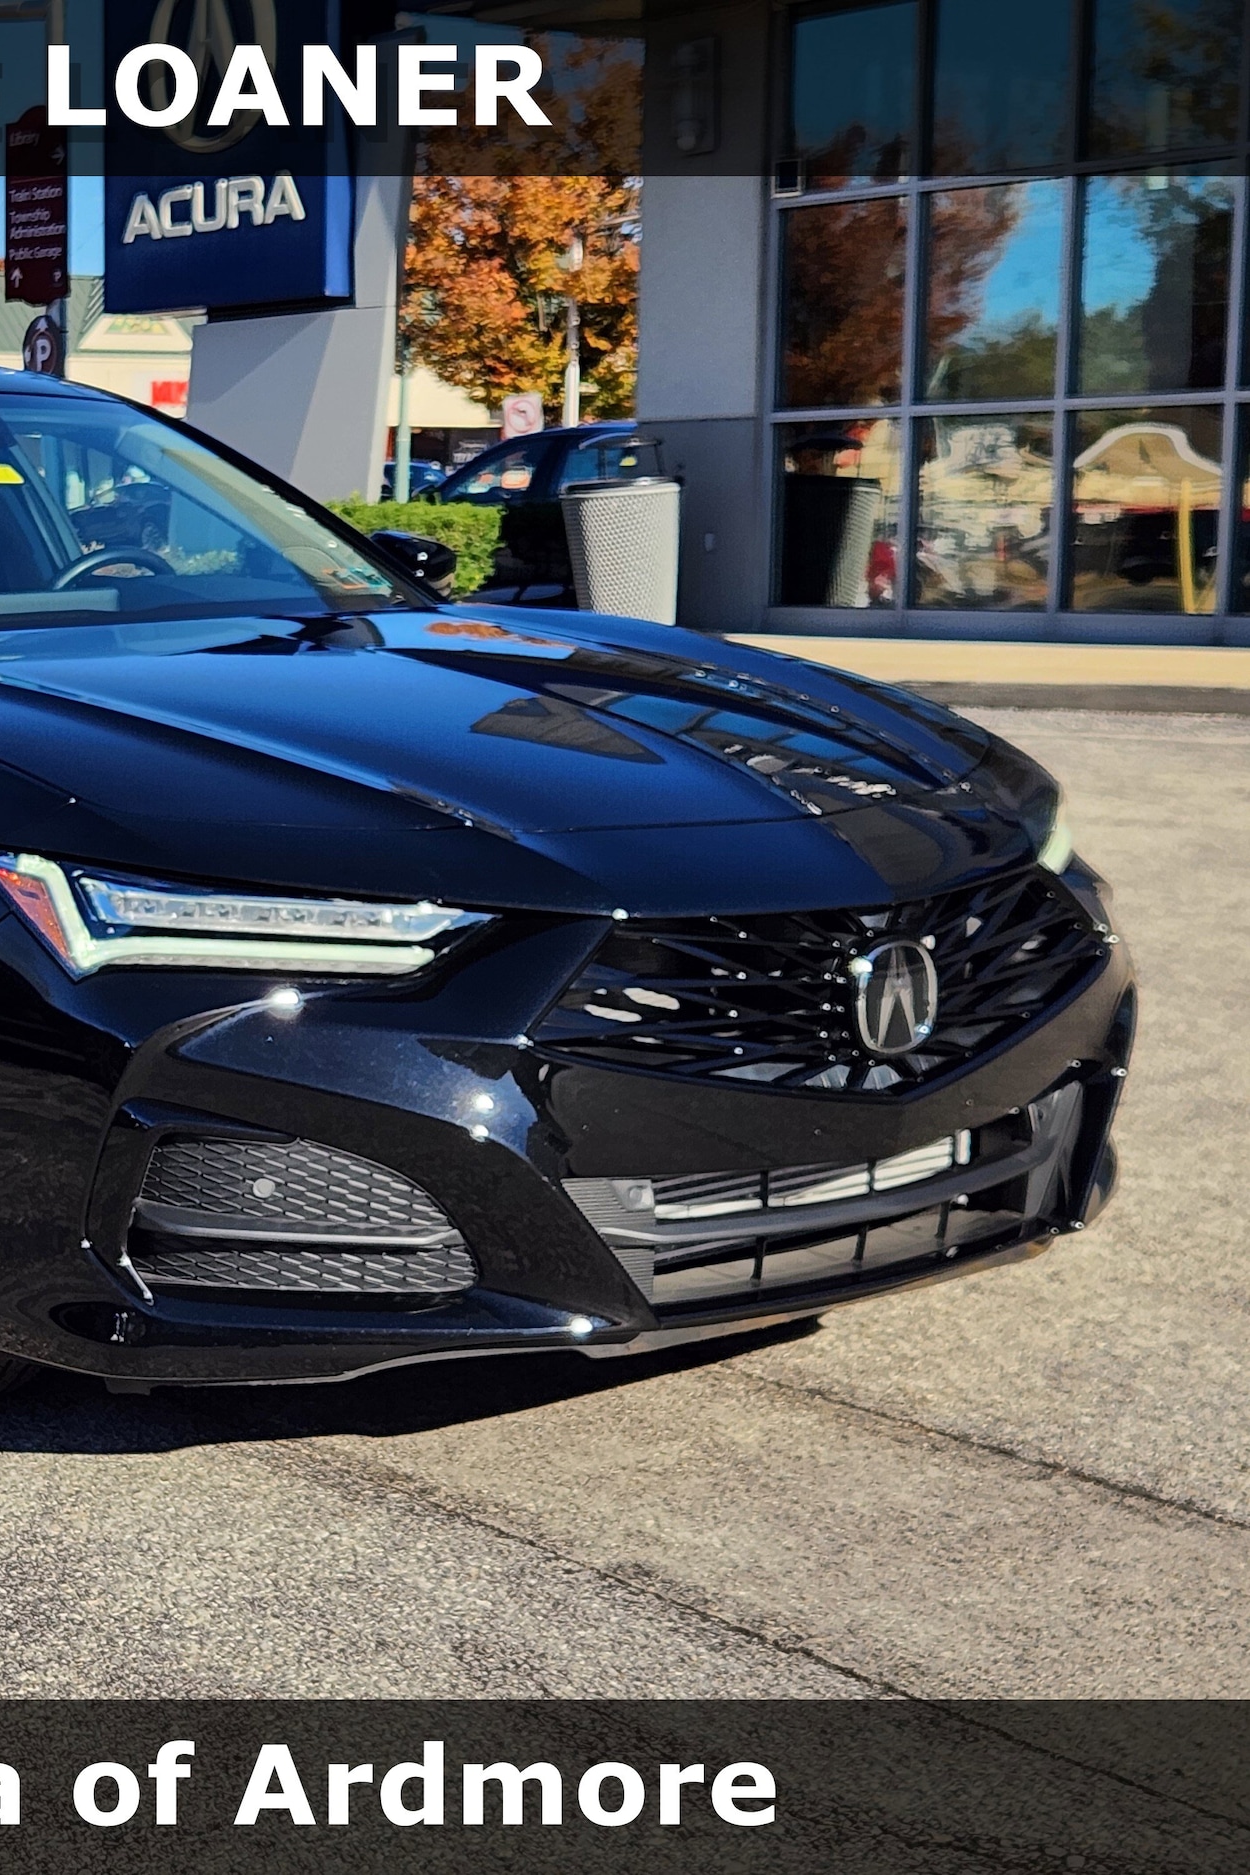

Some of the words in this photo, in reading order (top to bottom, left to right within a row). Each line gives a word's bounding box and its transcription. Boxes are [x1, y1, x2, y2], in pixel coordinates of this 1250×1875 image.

[9, 131, 40, 147] Library
[9, 188, 30, 203] Train
[32, 185, 63, 201] Station
[122, 168, 306, 244] ACURA
[9, 207, 51, 225] Township
[9, 223, 67, 240] Administration
[9, 247, 33, 261] Public
[34, 246, 63, 260] Garage
[36, 339, 52, 372] P
